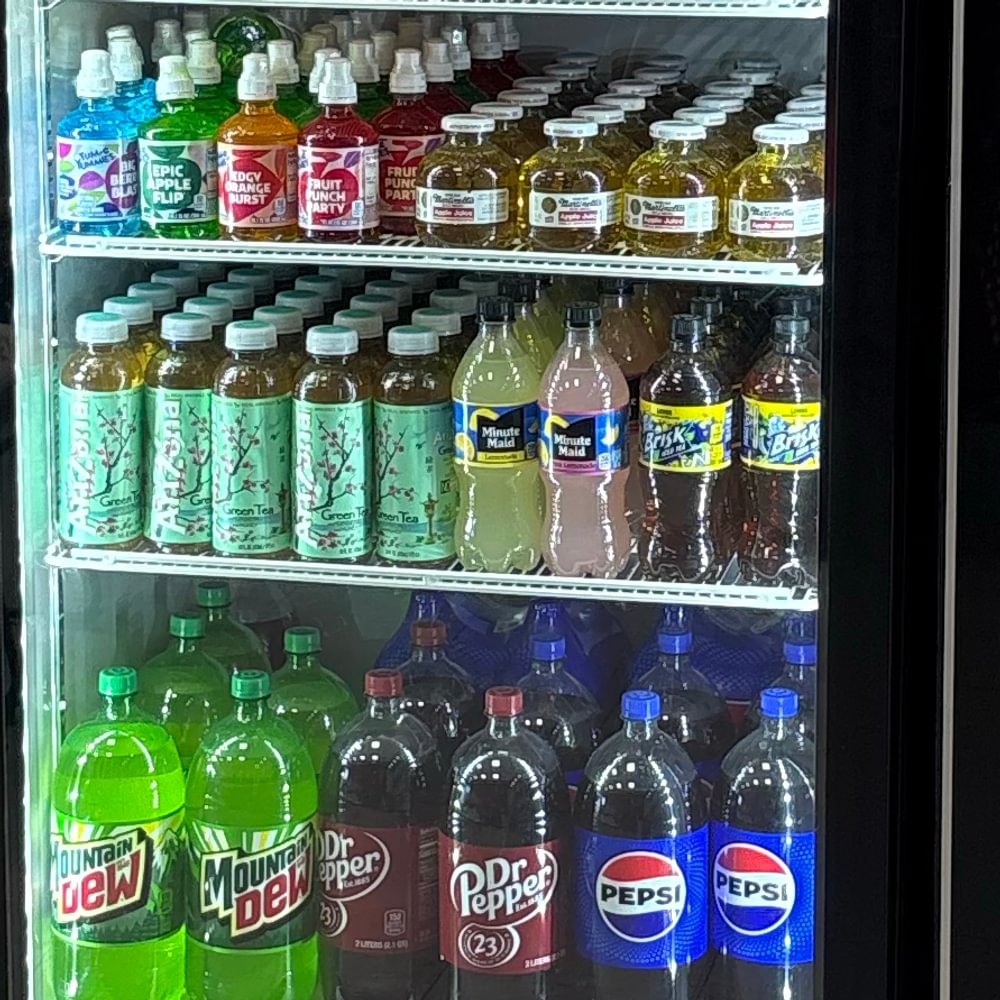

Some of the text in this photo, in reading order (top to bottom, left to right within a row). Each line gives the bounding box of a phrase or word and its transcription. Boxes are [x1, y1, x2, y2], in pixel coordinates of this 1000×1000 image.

[152, 164, 184, 177] EPIC
[387, 166, 418, 178] FRUI
[146, 178, 192, 190] APPLE
[225, 182, 271, 193] ORANGE
[308, 179, 343, 191] FRUIT
[385, 178, 416, 189] PUNC
[152, 192, 184, 204] FLIP
[385, 189, 417, 200] PART
[482, 426, 521, 438] Minute
[487, 438, 516, 449] Maid
[553, 433, 592, 446] Minute
[558, 445, 586, 457] Maid
[190, 494, 212, 506] Gre
[222, 504, 274, 516] Green Tea
[321, 508, 355, 521] Green
[400, 511, 419, 523] Tea
[324, 830, 355, 860] Dr
[319, 851, 381, 891] epper
[485, 857, 528, 891] Dr
[61, 850, 142, 914] DEW
[716, 869, 788, 902] PEPSI
[235, 850, 313, 930] DEW
[457, 862, 552, 921] Pepper
[601, 883, 681, 905] PEPSI
[473, 933, 498, 957] 23
